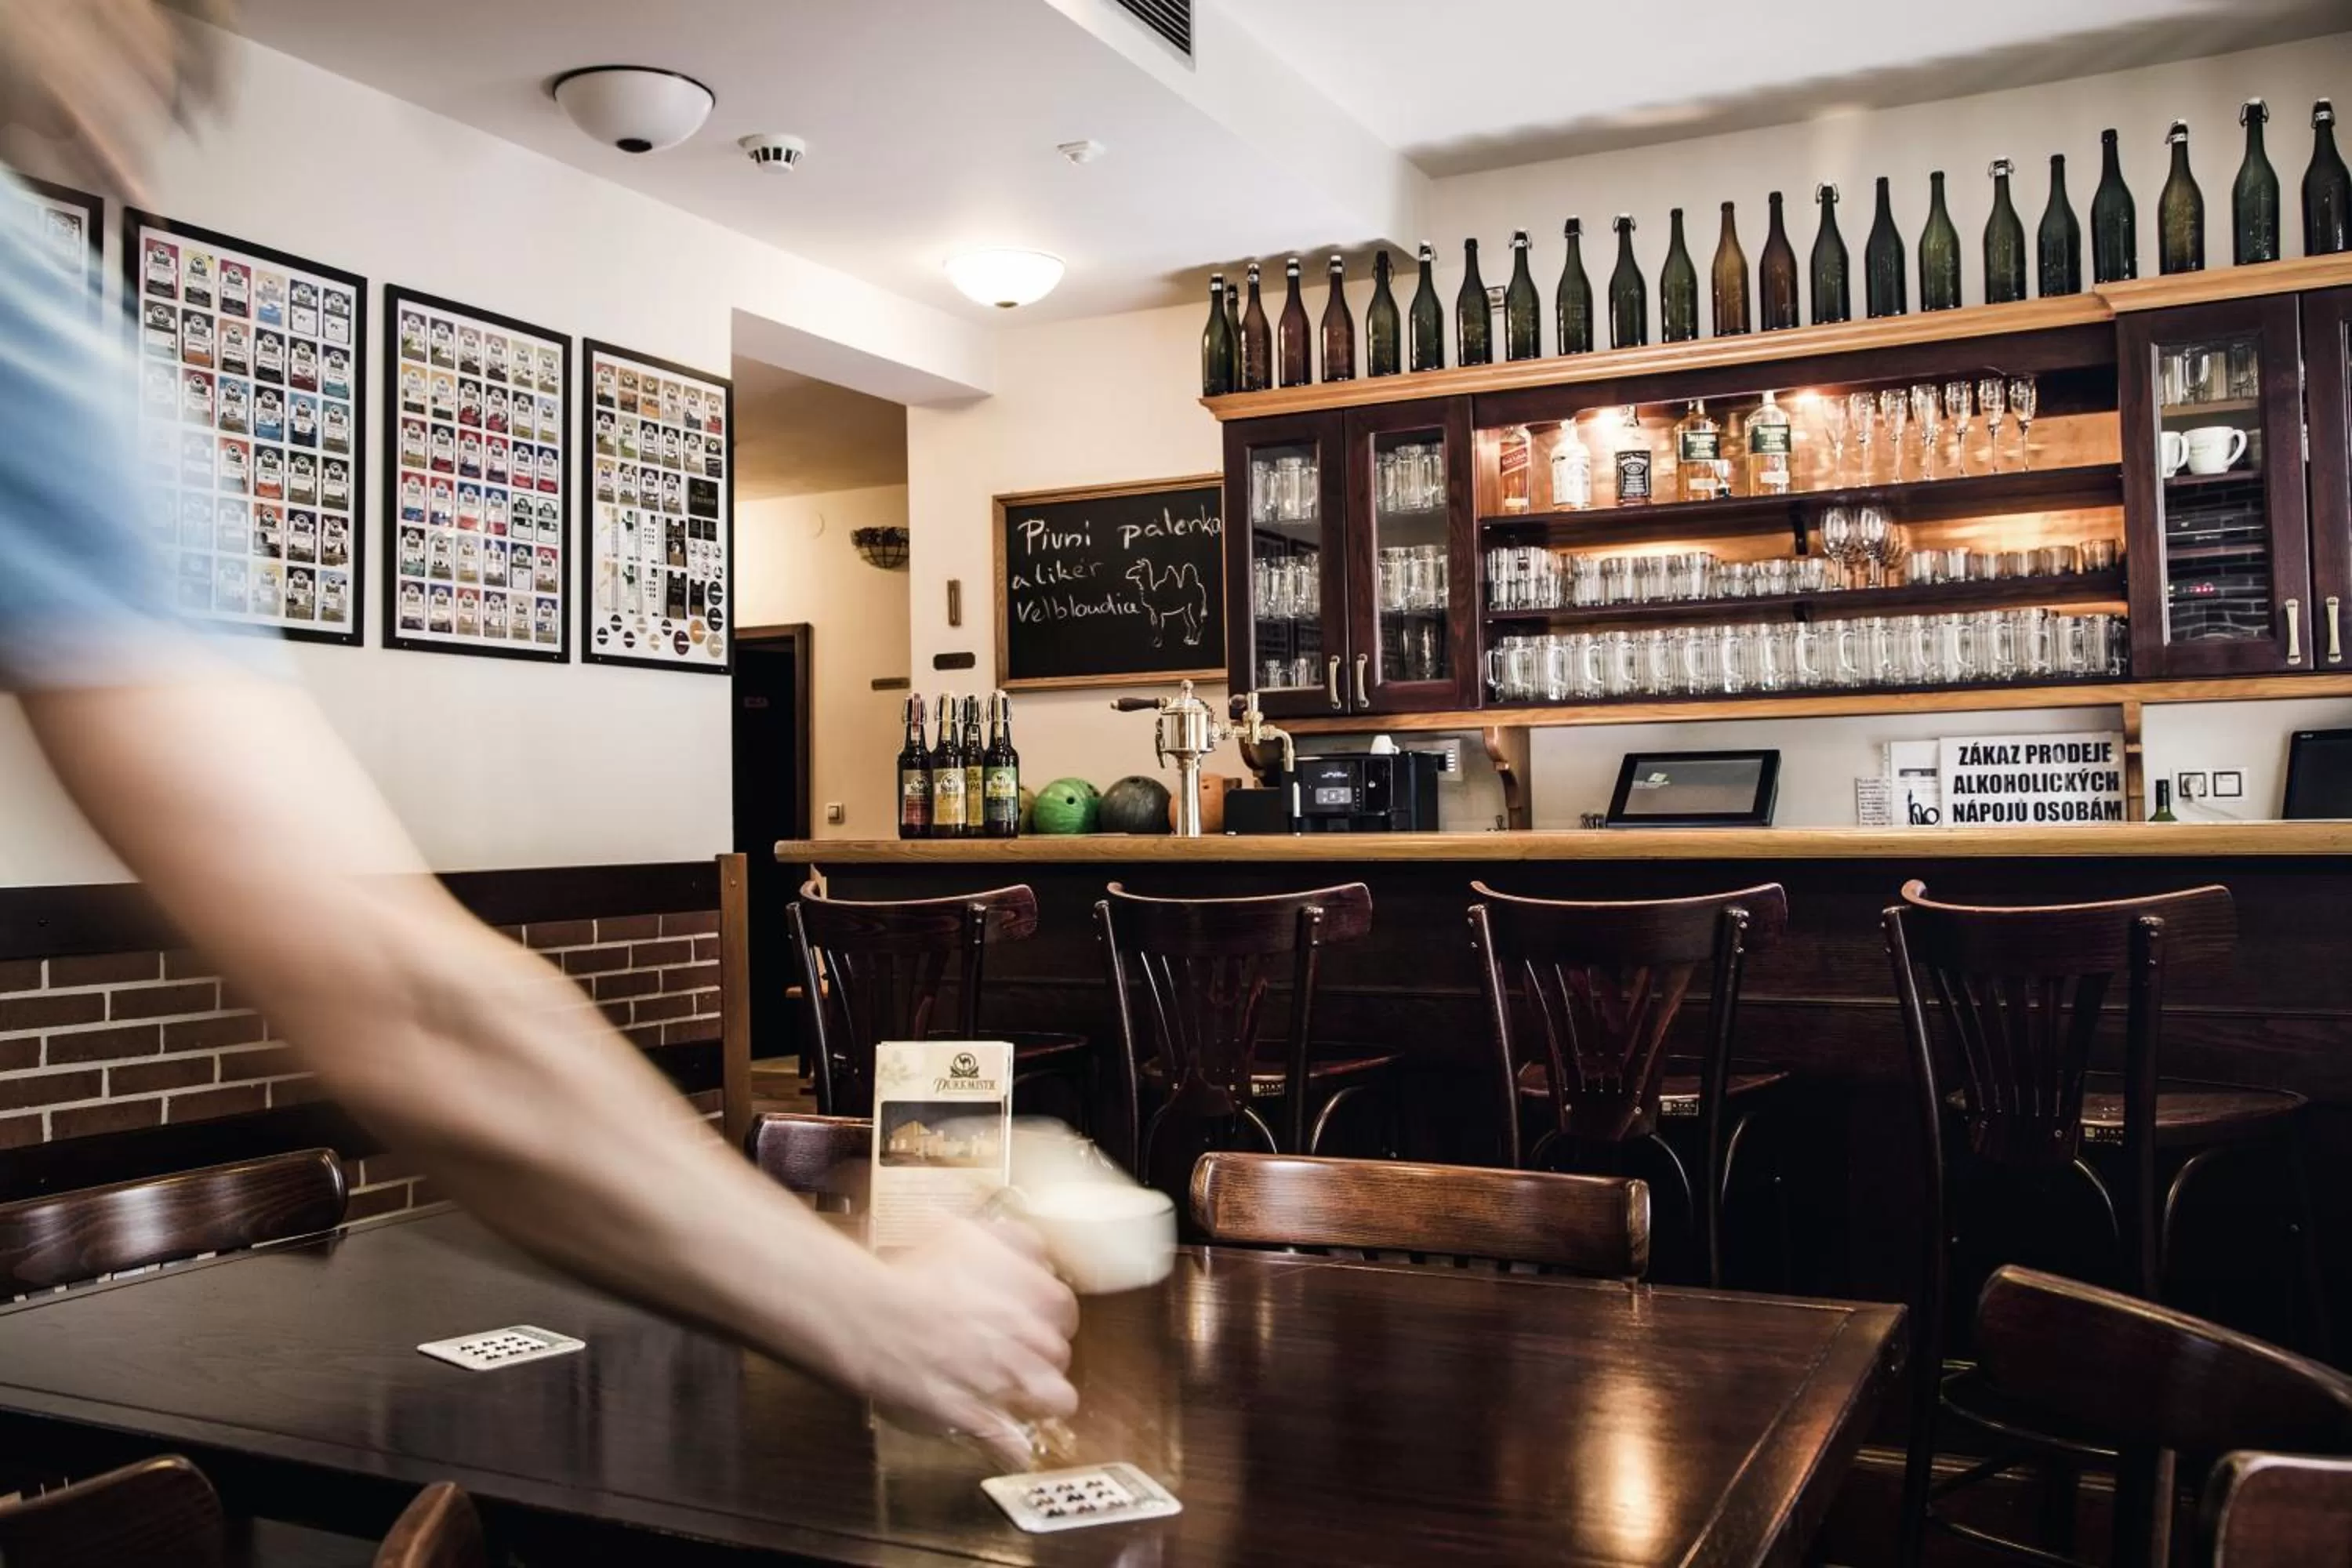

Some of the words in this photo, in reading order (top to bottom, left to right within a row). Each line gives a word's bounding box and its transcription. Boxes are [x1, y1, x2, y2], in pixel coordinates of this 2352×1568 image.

[1011, 574, 1032, 590] a
[1958, 742, 2020, 766] ZÁKAZ
[2025, 742, 2112, 764] PRODEJE
[1953, 768, 2119, 794] ALKOHOLICKÝCH
[2033, 797, 2122, 822] OSOBÁM
